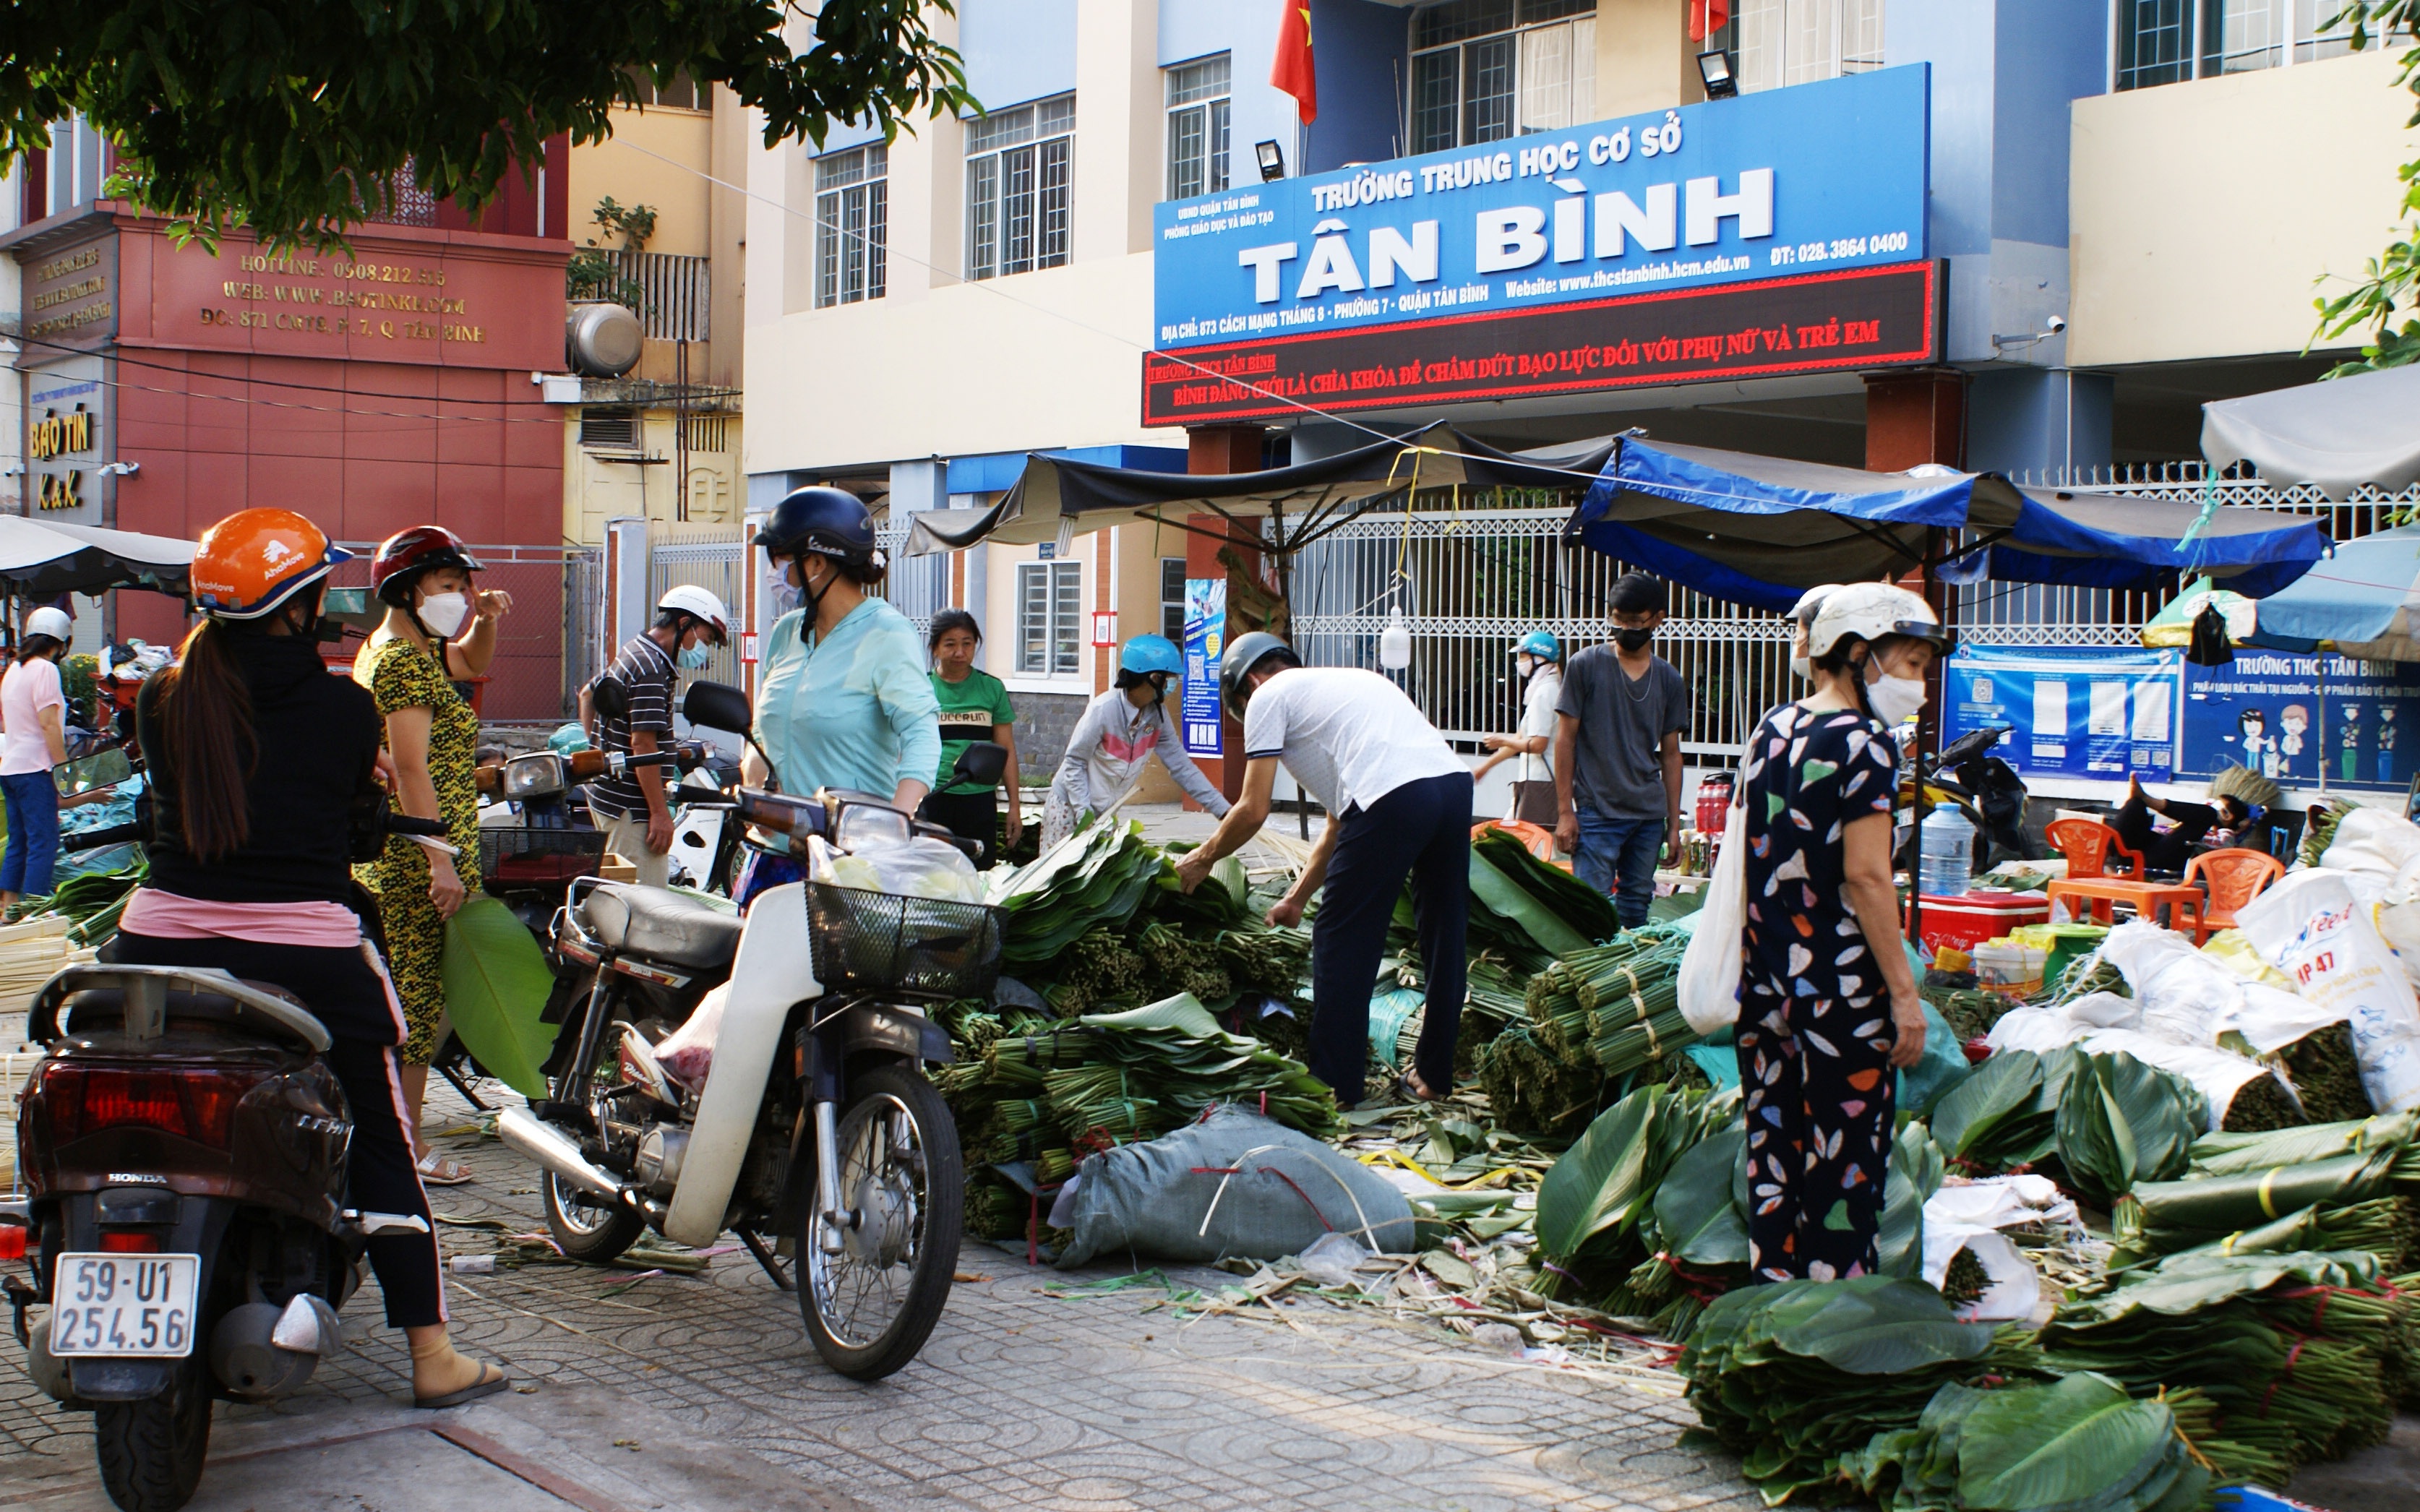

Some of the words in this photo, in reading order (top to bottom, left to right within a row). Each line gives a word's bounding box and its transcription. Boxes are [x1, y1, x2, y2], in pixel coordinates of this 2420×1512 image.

[1312, 169, 1413, 212] TRƯỜNG
[1420, 153, 1512, 194] TRUNG
[1519, 141, 1579, 183] HỌC
[1588, 126, 1631, 166] CƠ
[1640, 111, 1682, 158] SỞ
[1178, 206, 1198, 220] UBND
[1200, 202, 1221, 218] QUẬN
[1223, 197, 1239, 212] TÂN
[1240, 194, 1259, 210] BÌNH
[1164, 223, 1189, 240] PHÒNG
[1191, 220, 1209, 236] GIÁO
[1211, 220, 1227, 235] DỤC
[1228, 215, 1239, 229] VÀ
[1240, 211, 1256, 228] ĐÀO
[1258, 210, 1274, 227] TẠO
[1239, 219, 1438, 304] TÂN
[1475, 168, 1774, 275] BÌNH
[1770, 246, 1795, 266] ĐT:
[1869, 231, 1908, 254] 0400
[241, 255, 325, 278] HOTLINE:
[1506, 279, 1557, 298] Website:
[1559, 255, 1750, 292] www.thcstanbinh.hcm.edu.vn
[223, 280, 269, 301] WEB:
[199, 308, 233, 326] ĐC:
[239, 310, 269, 330] 871
[443, 319, 486, 343] BÌNH
[1162, 325, 1177, 344] ĐỊA
[1178, 317, 1198, 338] CHỈ:
[1199, 322, 1217, 337] 873
[1219, 314, 1246, 334] CÁCH
[1248, 314, 1277, 333] MẠNG
[1279, 306, 1316, 327] THÁNG
[1318, 306, 1324, 321] 8
[1334, 296, 1379, 319] PHƯỜNG
[1381, 298, 1388, 313] 7
[1398, 293, 1430, 314] QUẬN
[1433, 286, 1456, 306] TÂN
[1459, 282, 1488, 304] BÌNH
[1172, 385, 1206, 407] BÌNH
[1209, 377, 1249, 402] ĐẲNG
[1250, 375, 1285, 398] GIỚI
[1287, 371, 1308, 395] LÀ
[1310, 369, 1348, 393] CHÌA
[1351, 364, 1397, 390] KHÓA
[1399, 359, 1423, 385] ĐỂ
[1424, 355, 1475, 383] CHẤM
[1478, 352, 1515, 379] DỨT
[1518, 352, 1557, 379] BẠO
[1559, 345, 1600, 375] LỰC
[1602, 338, 1639, 368] ĐỐI
[1642, 335, 1679, 362] VỚI
[1681, 335, 1723, 361] PHỤ
[1726, 327, 1761, 356] NỮ
[1762, 323, 1793, 351] VÀ
[1796, 317, 1840, 349] TRẺ
[1843, 319, 1880, 345] EM
[1194, 358, 1222, 377] THCS
[1224, 353, 1245, 373] TÂN
[1248, 352, 1276, 371] BÌNH
[264, 552, 306, 581] AhaMove
[197, 580, 235, 593] AhaMove
[2234, 654, 2292, 676] TRƯỜNG
[2329, 656, 2357, 676] TÂN
[2233, 682, 2248, 693] RÁC
[2249, 681, 2267, 694] THẢI
[2267, 683, 2280, 697] TẠI
[108, 1173, 168, 1184] HONDA
[76, 1260, 172, 1303] 59-U1
[59, 1307, 185, 1349] 254.56
